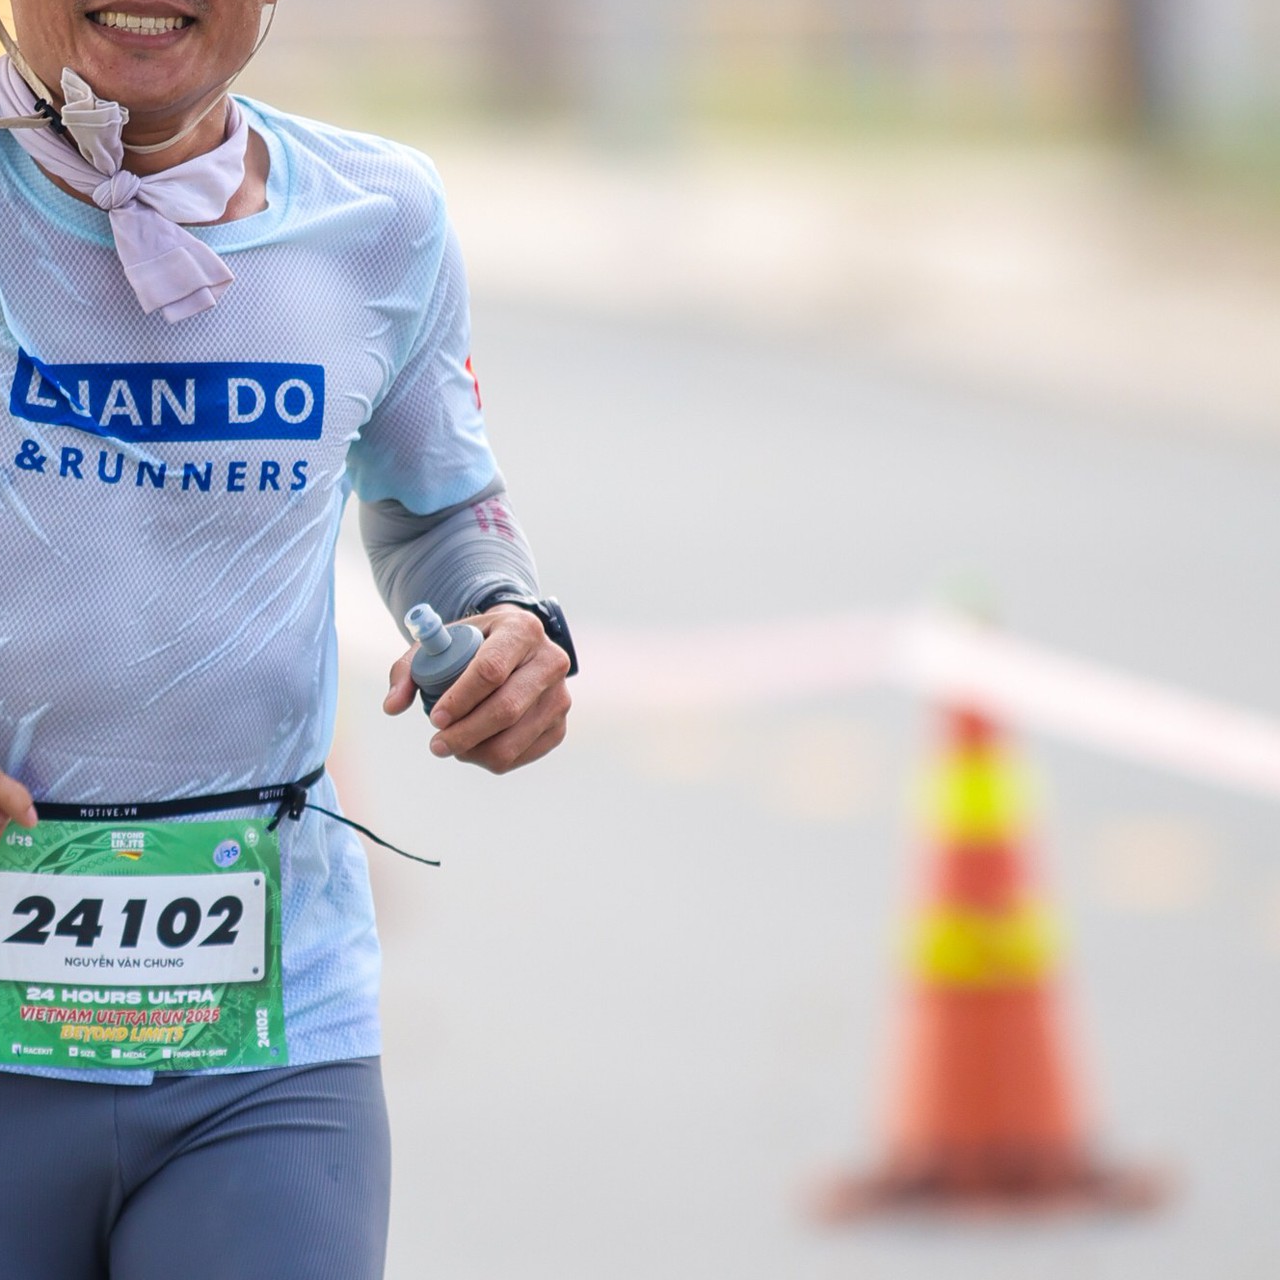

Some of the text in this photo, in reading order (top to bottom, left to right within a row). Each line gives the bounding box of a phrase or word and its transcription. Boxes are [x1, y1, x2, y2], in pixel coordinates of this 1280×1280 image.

[227, 377, 315, 424] DO
[14, 438, 309, 492] &RUNNERS
[80, 807, 138, 817] MOTIVE.VN
[111, 831, 144, 839] BEYOND
[2, 895, 244, 949] 24102
[143, 958, 184, 968] CHUNG
[26, 987, 215, 1004] 24 HOURS ULTRA
[20, 1005, 221, 1026] VIETNAM ULTRA RUN 2025
[60, 1024, 184, 1043] BEYOND LIMITS
[256, 1008, 270, 1048] 24102
